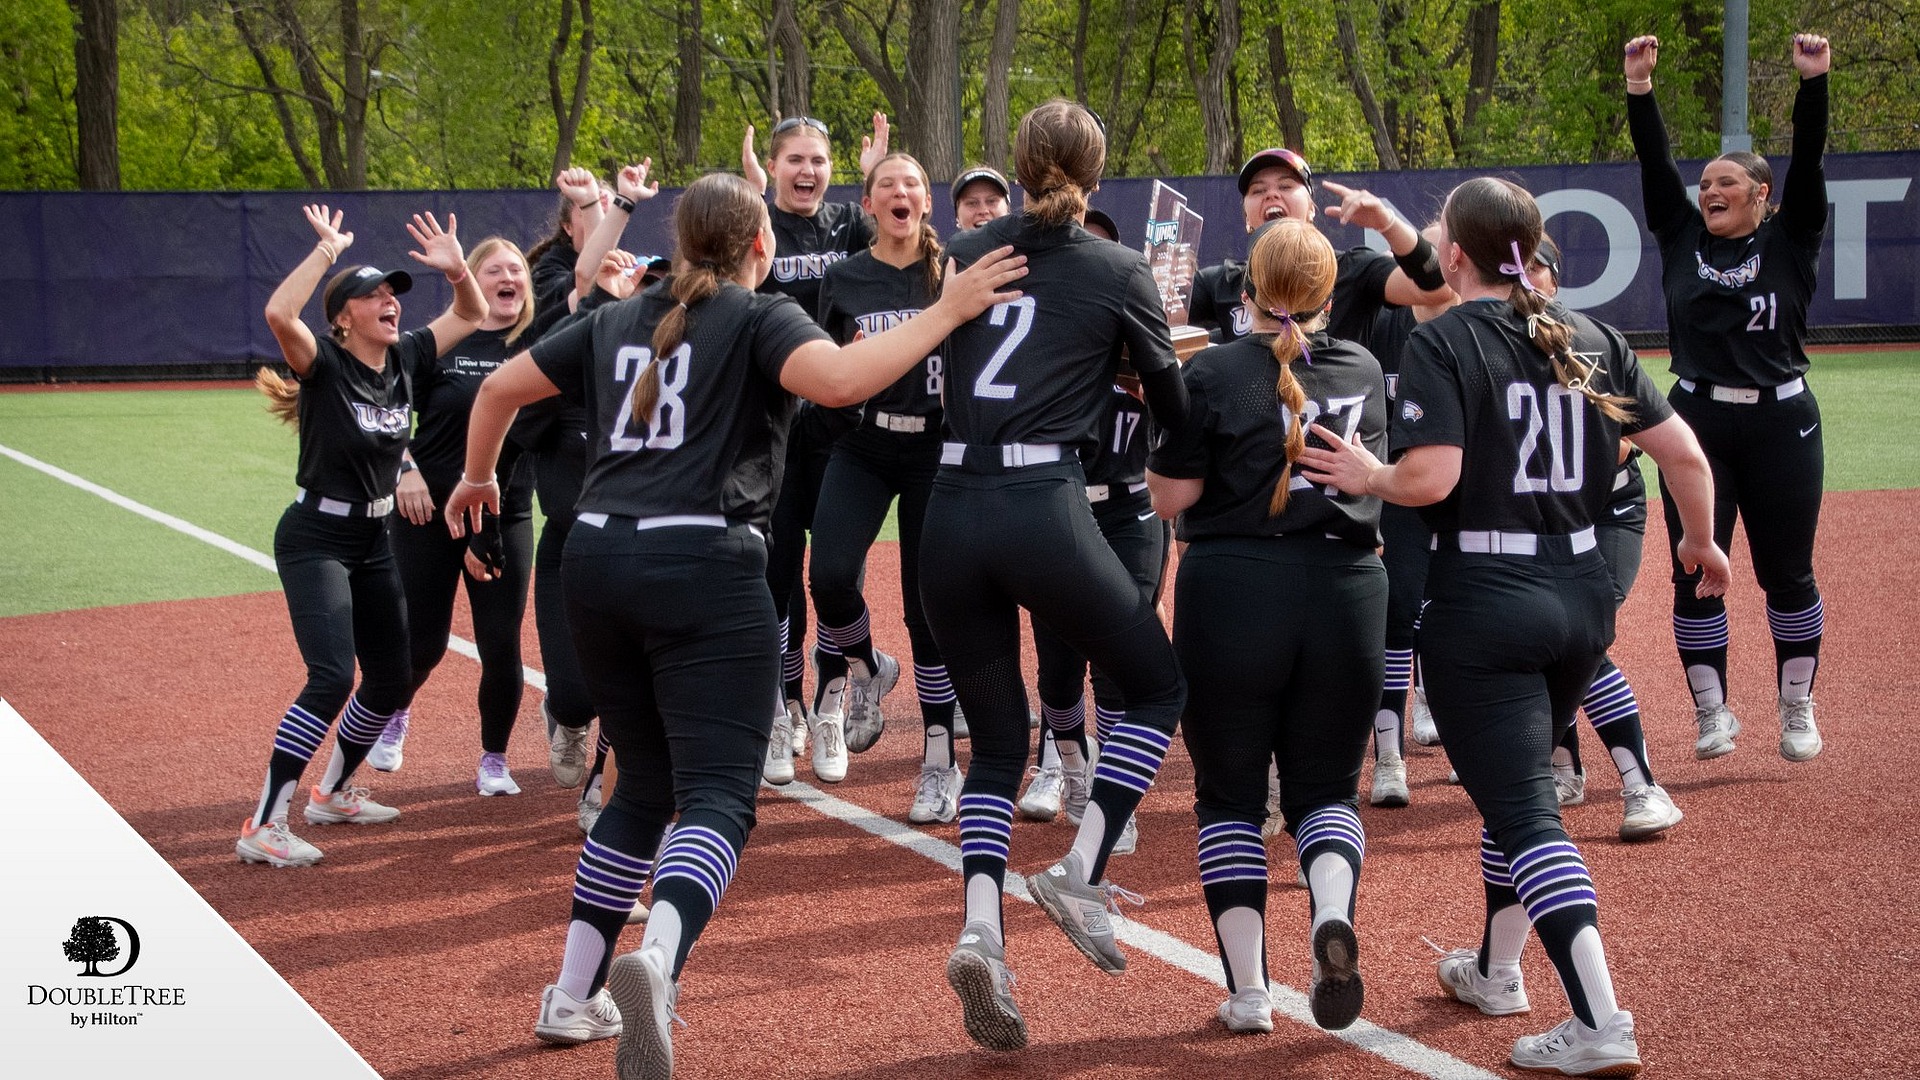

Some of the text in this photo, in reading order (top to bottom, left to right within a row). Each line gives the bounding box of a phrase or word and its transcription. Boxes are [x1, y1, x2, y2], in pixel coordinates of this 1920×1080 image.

[1155, 224, 1177, 242] UMAC
[1746, 292, 1776, 332] 21
[974, 296, 1035, 399] 2
[926, 355, 942, 395] 8
[610, 343, 691, 451] 28
[1112, 411, 1140, 454] 17
[1507, 382, 1584, 493] 20
